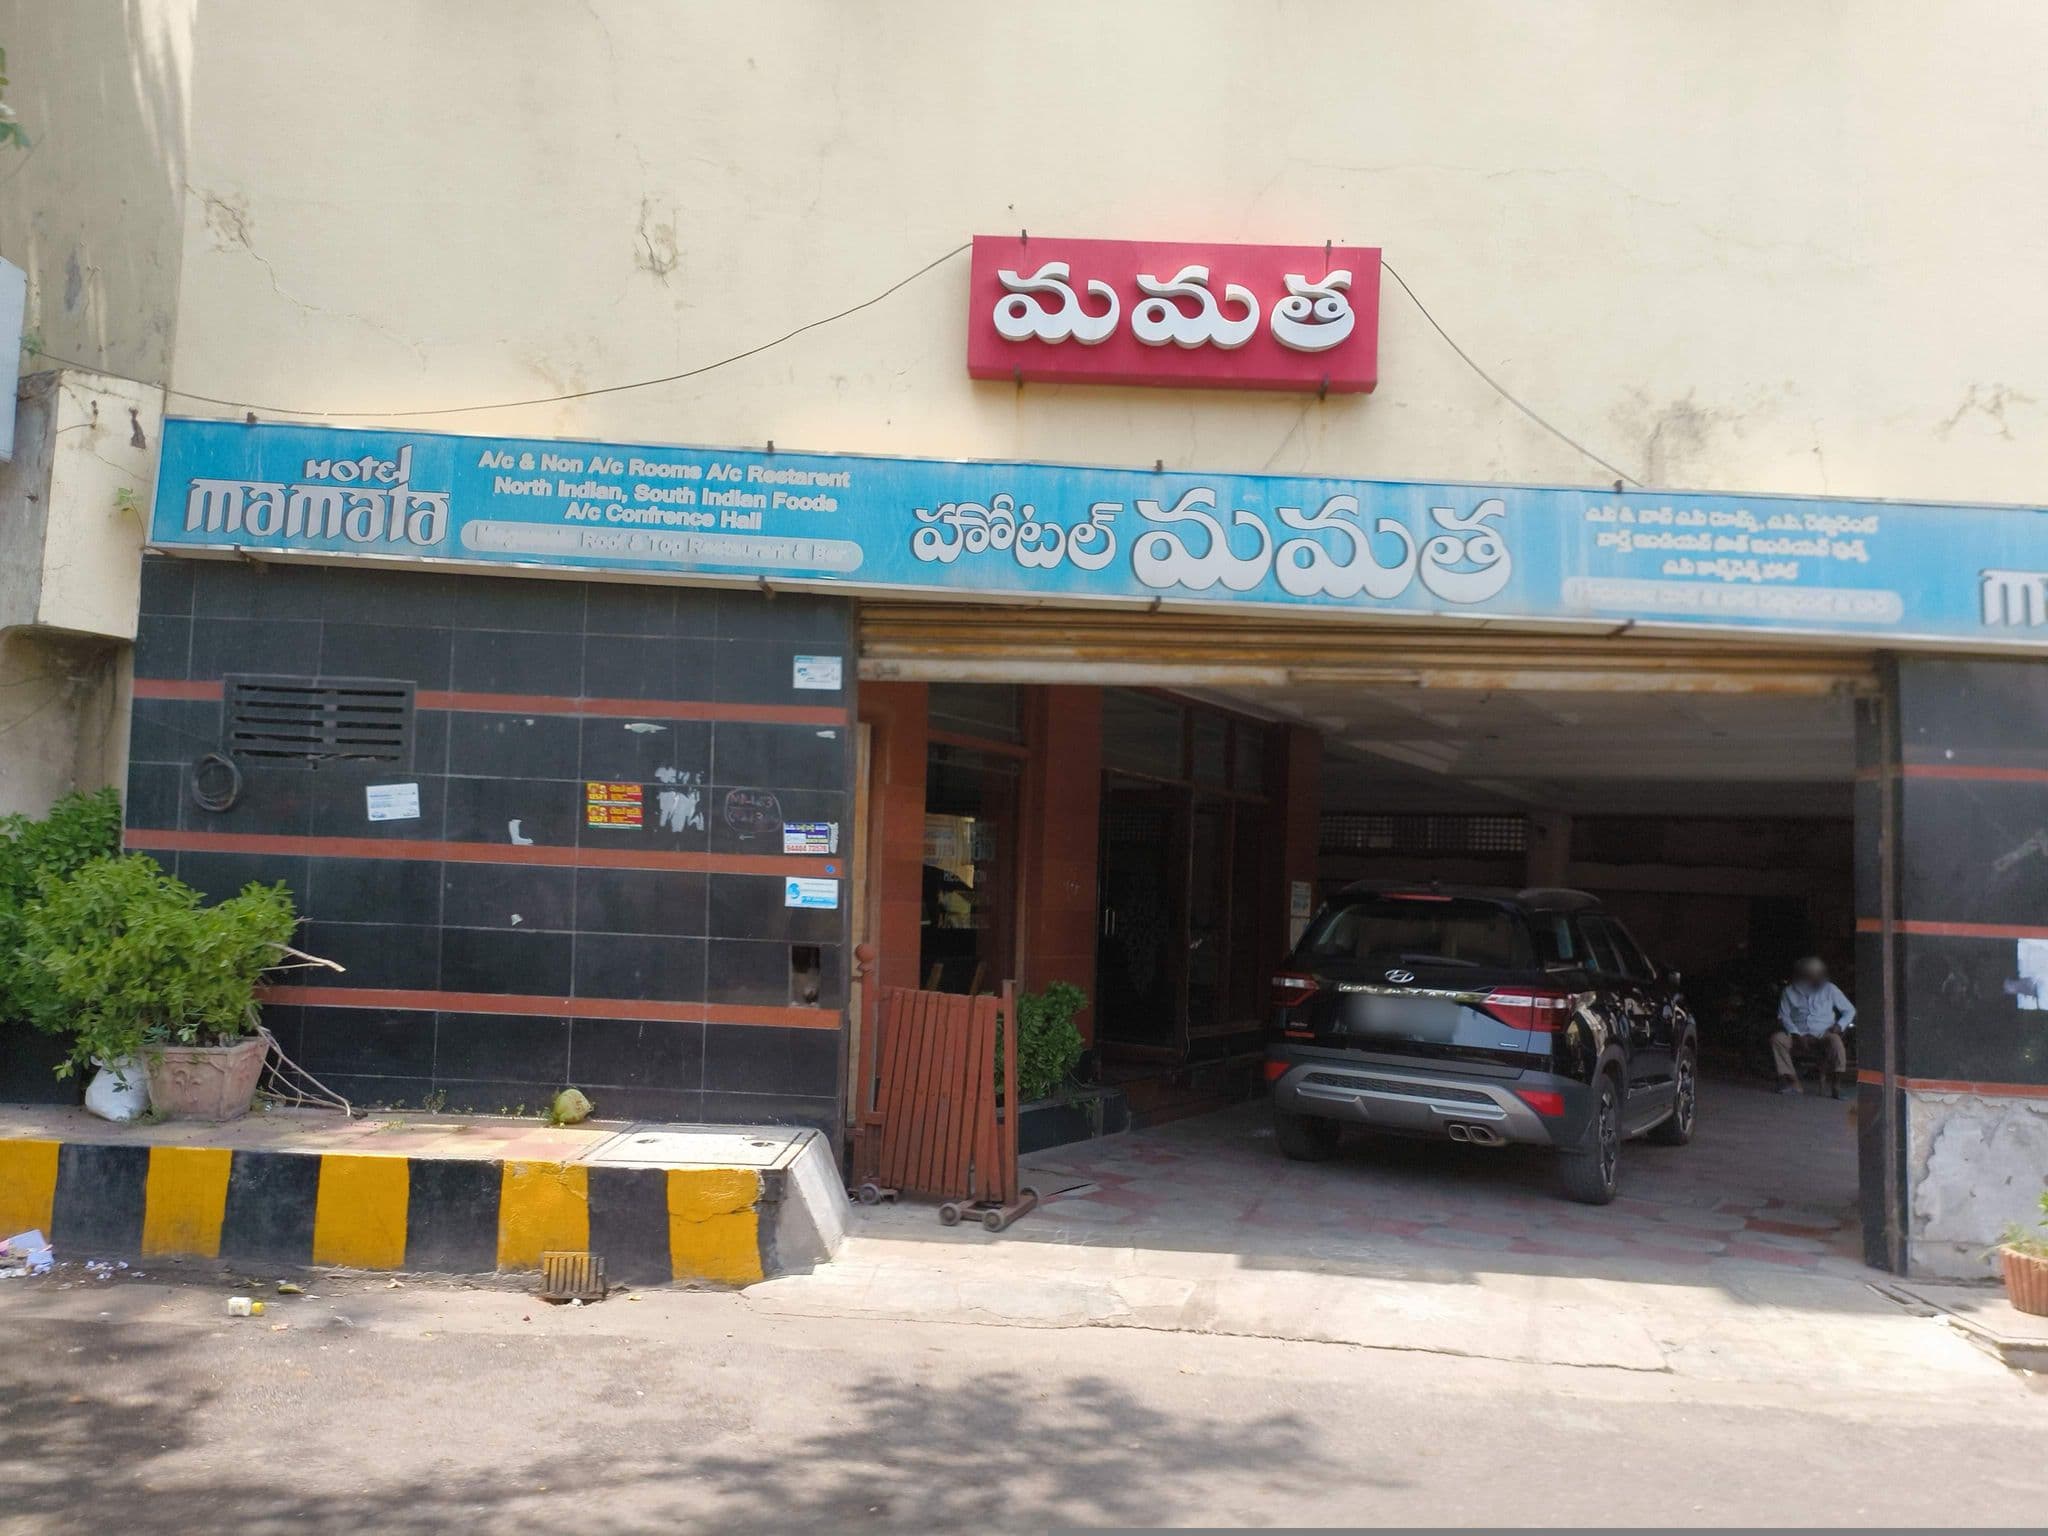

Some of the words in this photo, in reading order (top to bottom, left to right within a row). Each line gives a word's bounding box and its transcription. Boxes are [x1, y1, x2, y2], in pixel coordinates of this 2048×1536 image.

[993, 261, 1355, 353] మమత
[479, 450, 515, 469] A/c
[519, 453, 536, 471] &
[541, 454, 584, 473] Non
[588, 456, 625, 475] A/c
[629, 459, 702, 480] Rooms
[706, 462, 743, 482] A/c
[495, 476, 551, 496] North
[558, 479, 628, 503] Indian,
[633, 484, 696, 505] South
[702, 488, 767, 509] Indian
[772, 491, 838, 512] Foods
[564, 501, 601, 521] A/c
[605, 503, 715, 527] Confrence
[720, 510, 763, 530] Hall
[1131, 487, 1513, 604] మమత
